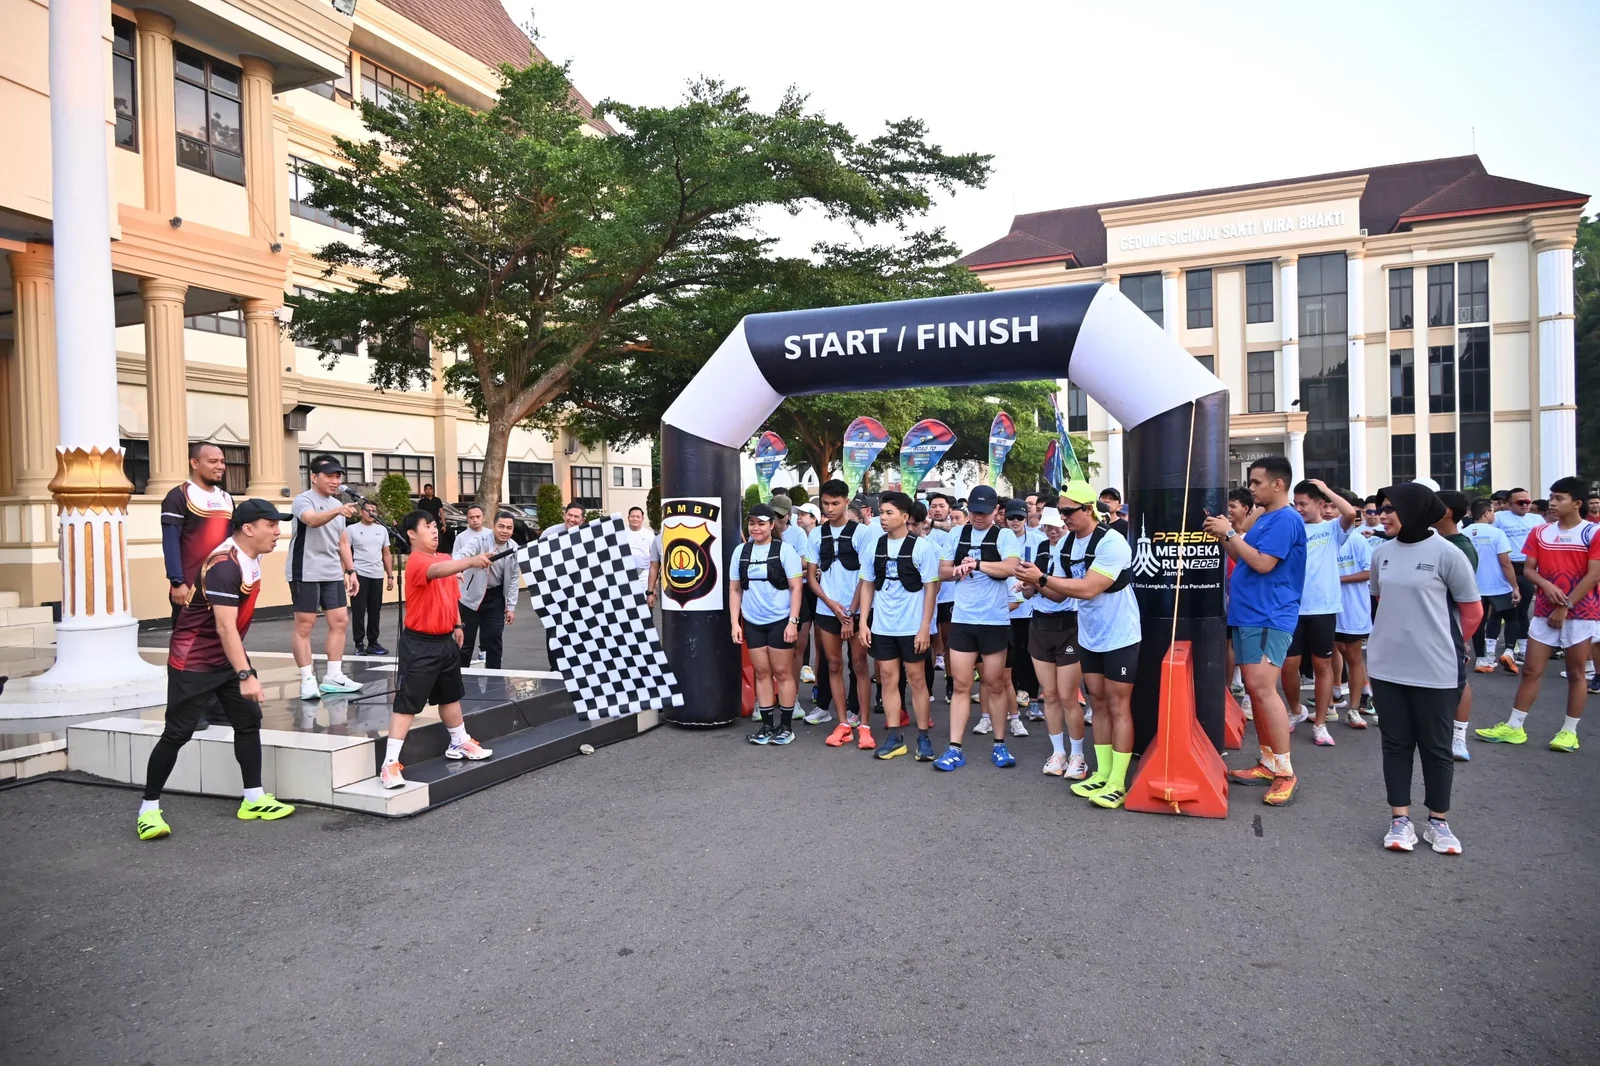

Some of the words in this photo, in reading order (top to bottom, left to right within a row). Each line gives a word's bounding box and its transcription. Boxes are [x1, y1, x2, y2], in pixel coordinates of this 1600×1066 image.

[1120, 234, 1166, 251] GEDUNG
[1169, 227, 1219, 245] SIGINJAI
[1221, 222, 1258, 239] SAKTI
[1263, 216, 1294, 234] WIRA
[1299, 210, 1345, 230] BHAKTI
[784, 327, 888, 360] START
[917, 315, 1039, 350] FINISH
[661, 504, 714, 518] AMBI
[1155, 545, 1220, 557] MERDEKA
[1161, 559, 1190, 570] RUN
